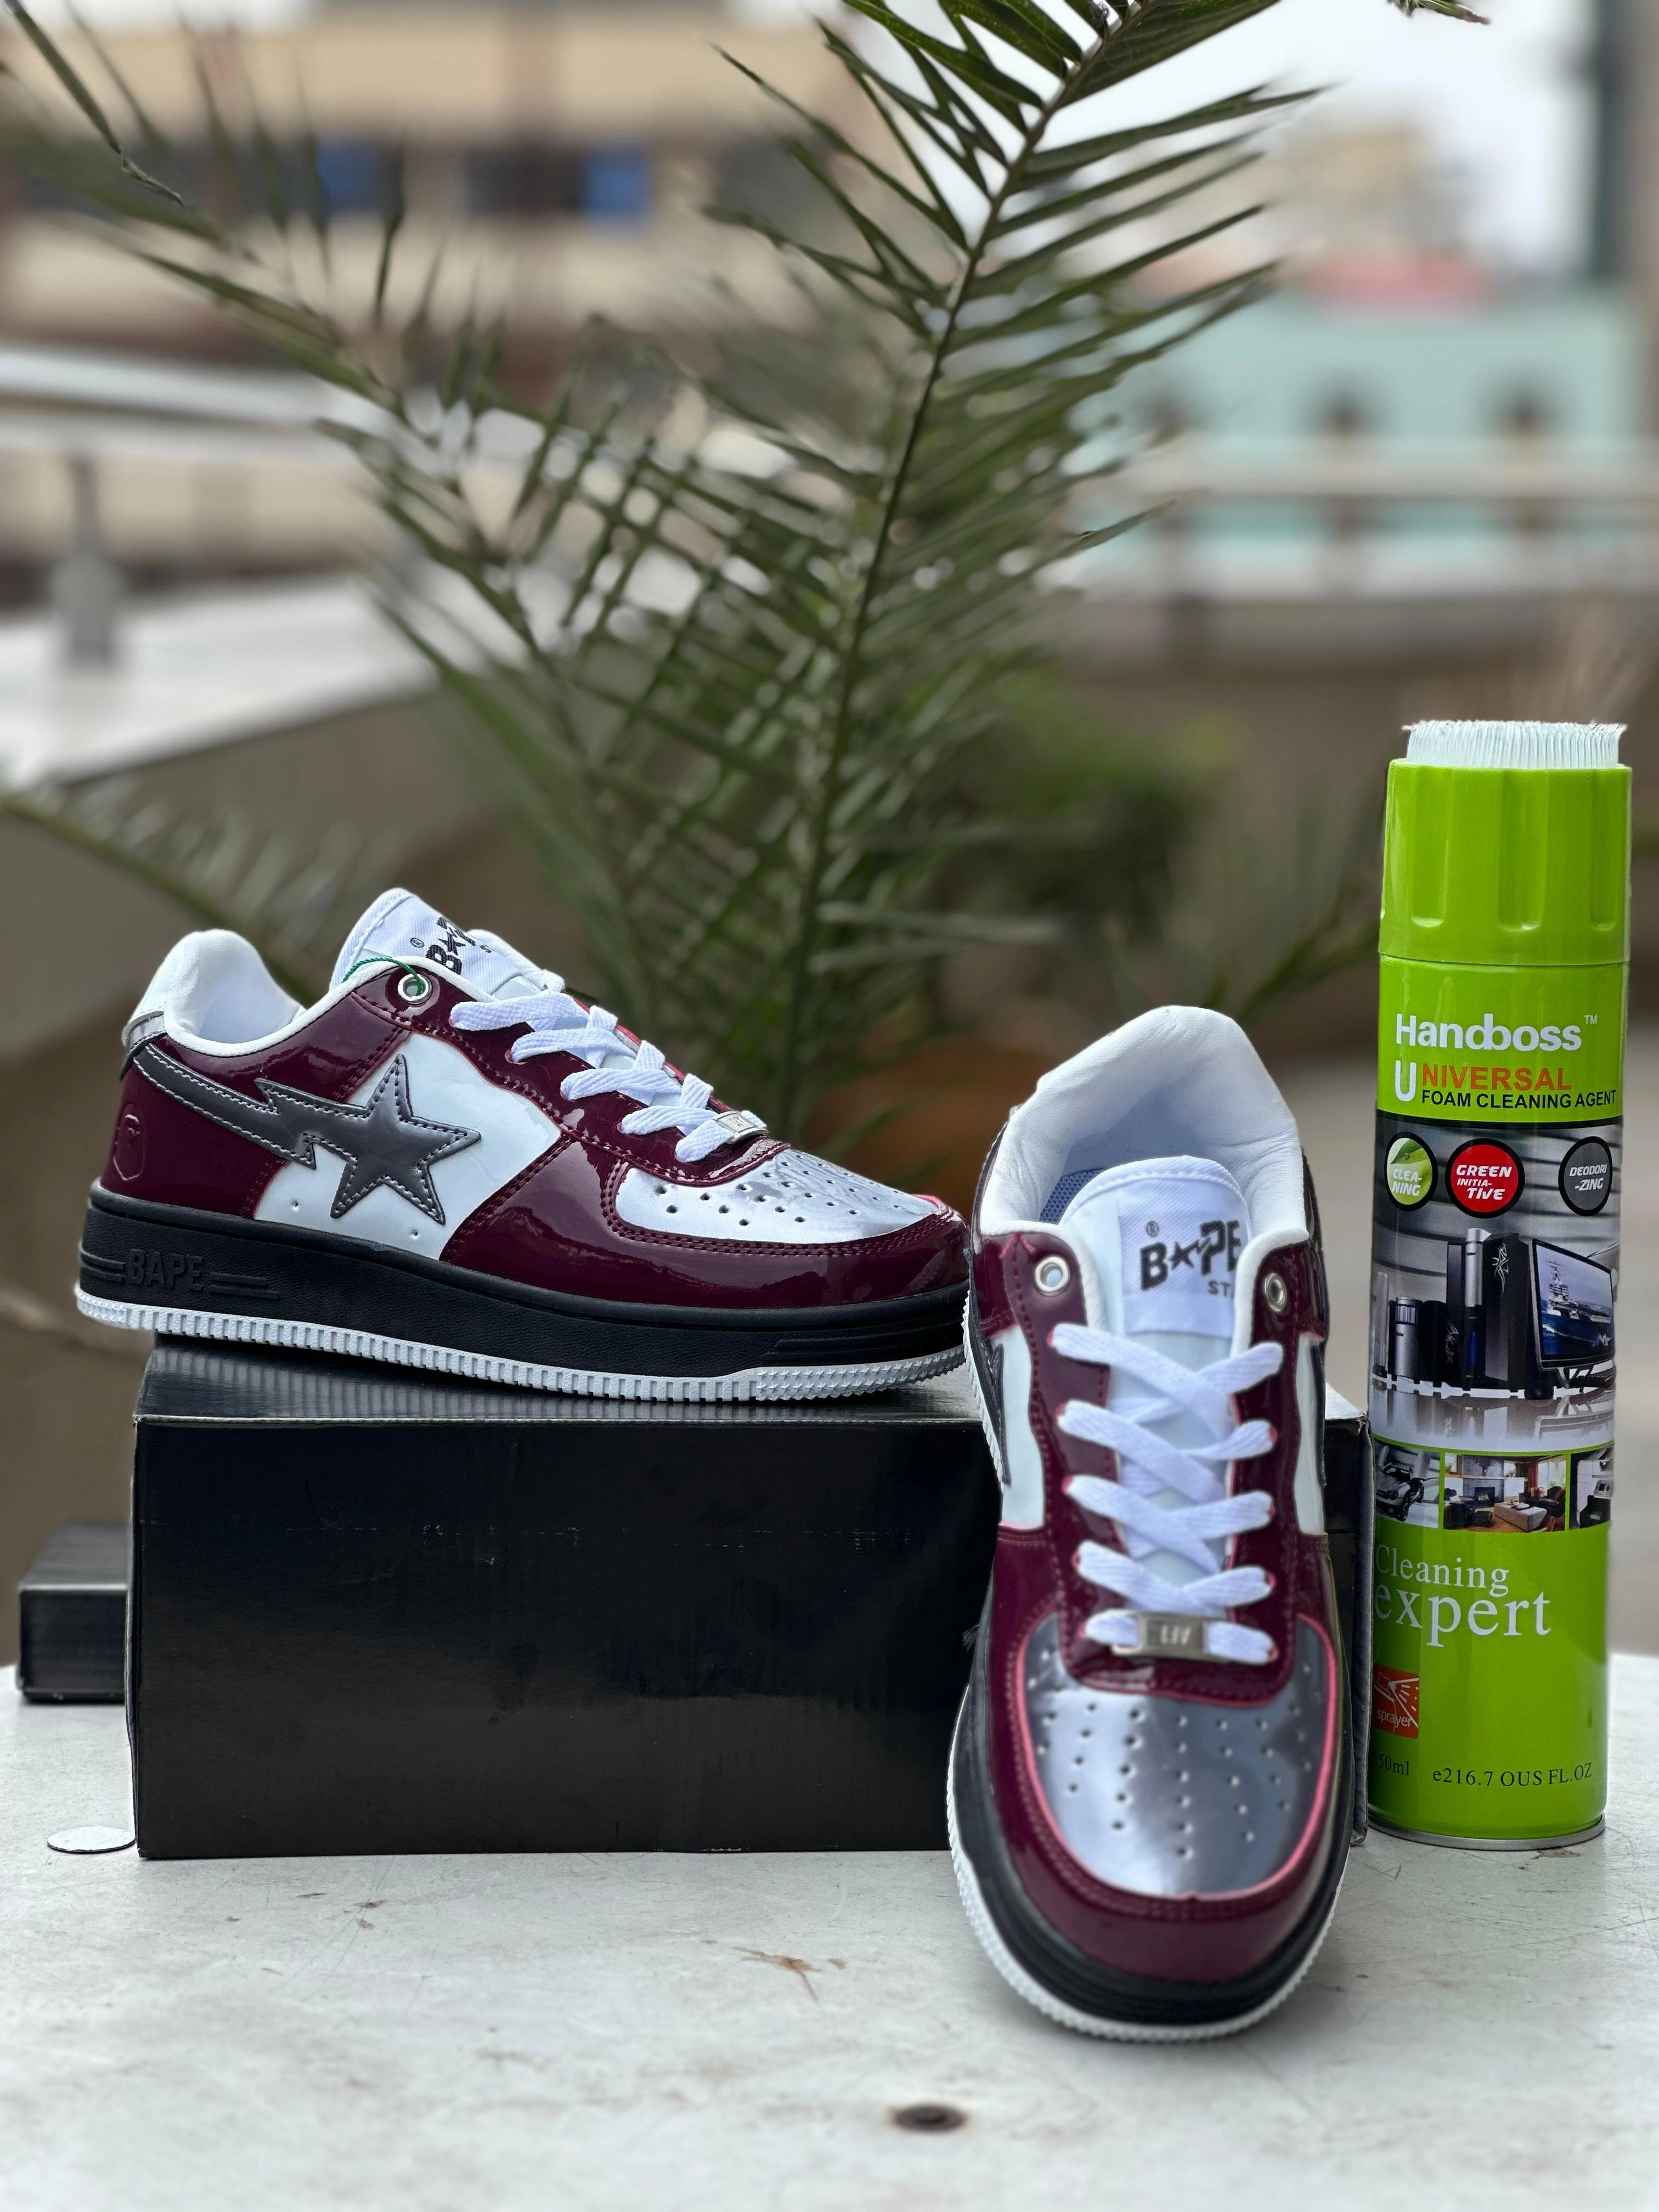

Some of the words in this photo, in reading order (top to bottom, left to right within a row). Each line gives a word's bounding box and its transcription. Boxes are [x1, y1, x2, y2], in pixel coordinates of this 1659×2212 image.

[1396, 1013, 1582, 1051] Handboss
[1421, 1090, 1471, 1108] FOAM
[1476, 1092, 1572, 1109] CLEANING
[1574, 1090, 1617, 1108] AGENT
[1456, 1165, 1512, 1178] GREEN
[1569, 1164, 1607, 1177] DEODORI
[1392, 1181, 1421, 1197] NING
[1457, 1178, 1492, 1187] INITIA-
[1466, 1188, 1505, 1201] TIVE
[127, 1249, 204, 1291] BAPE
[1209, 1280, 1234, 1299] ST
[1376, 1544, 1510, 1598] Cleaning
[1374, 1584, 1551, 1647] expert
[1378, 1709, 1412, 1728] sprayer
[1432, 1768, 1493, 1786] e216.7
